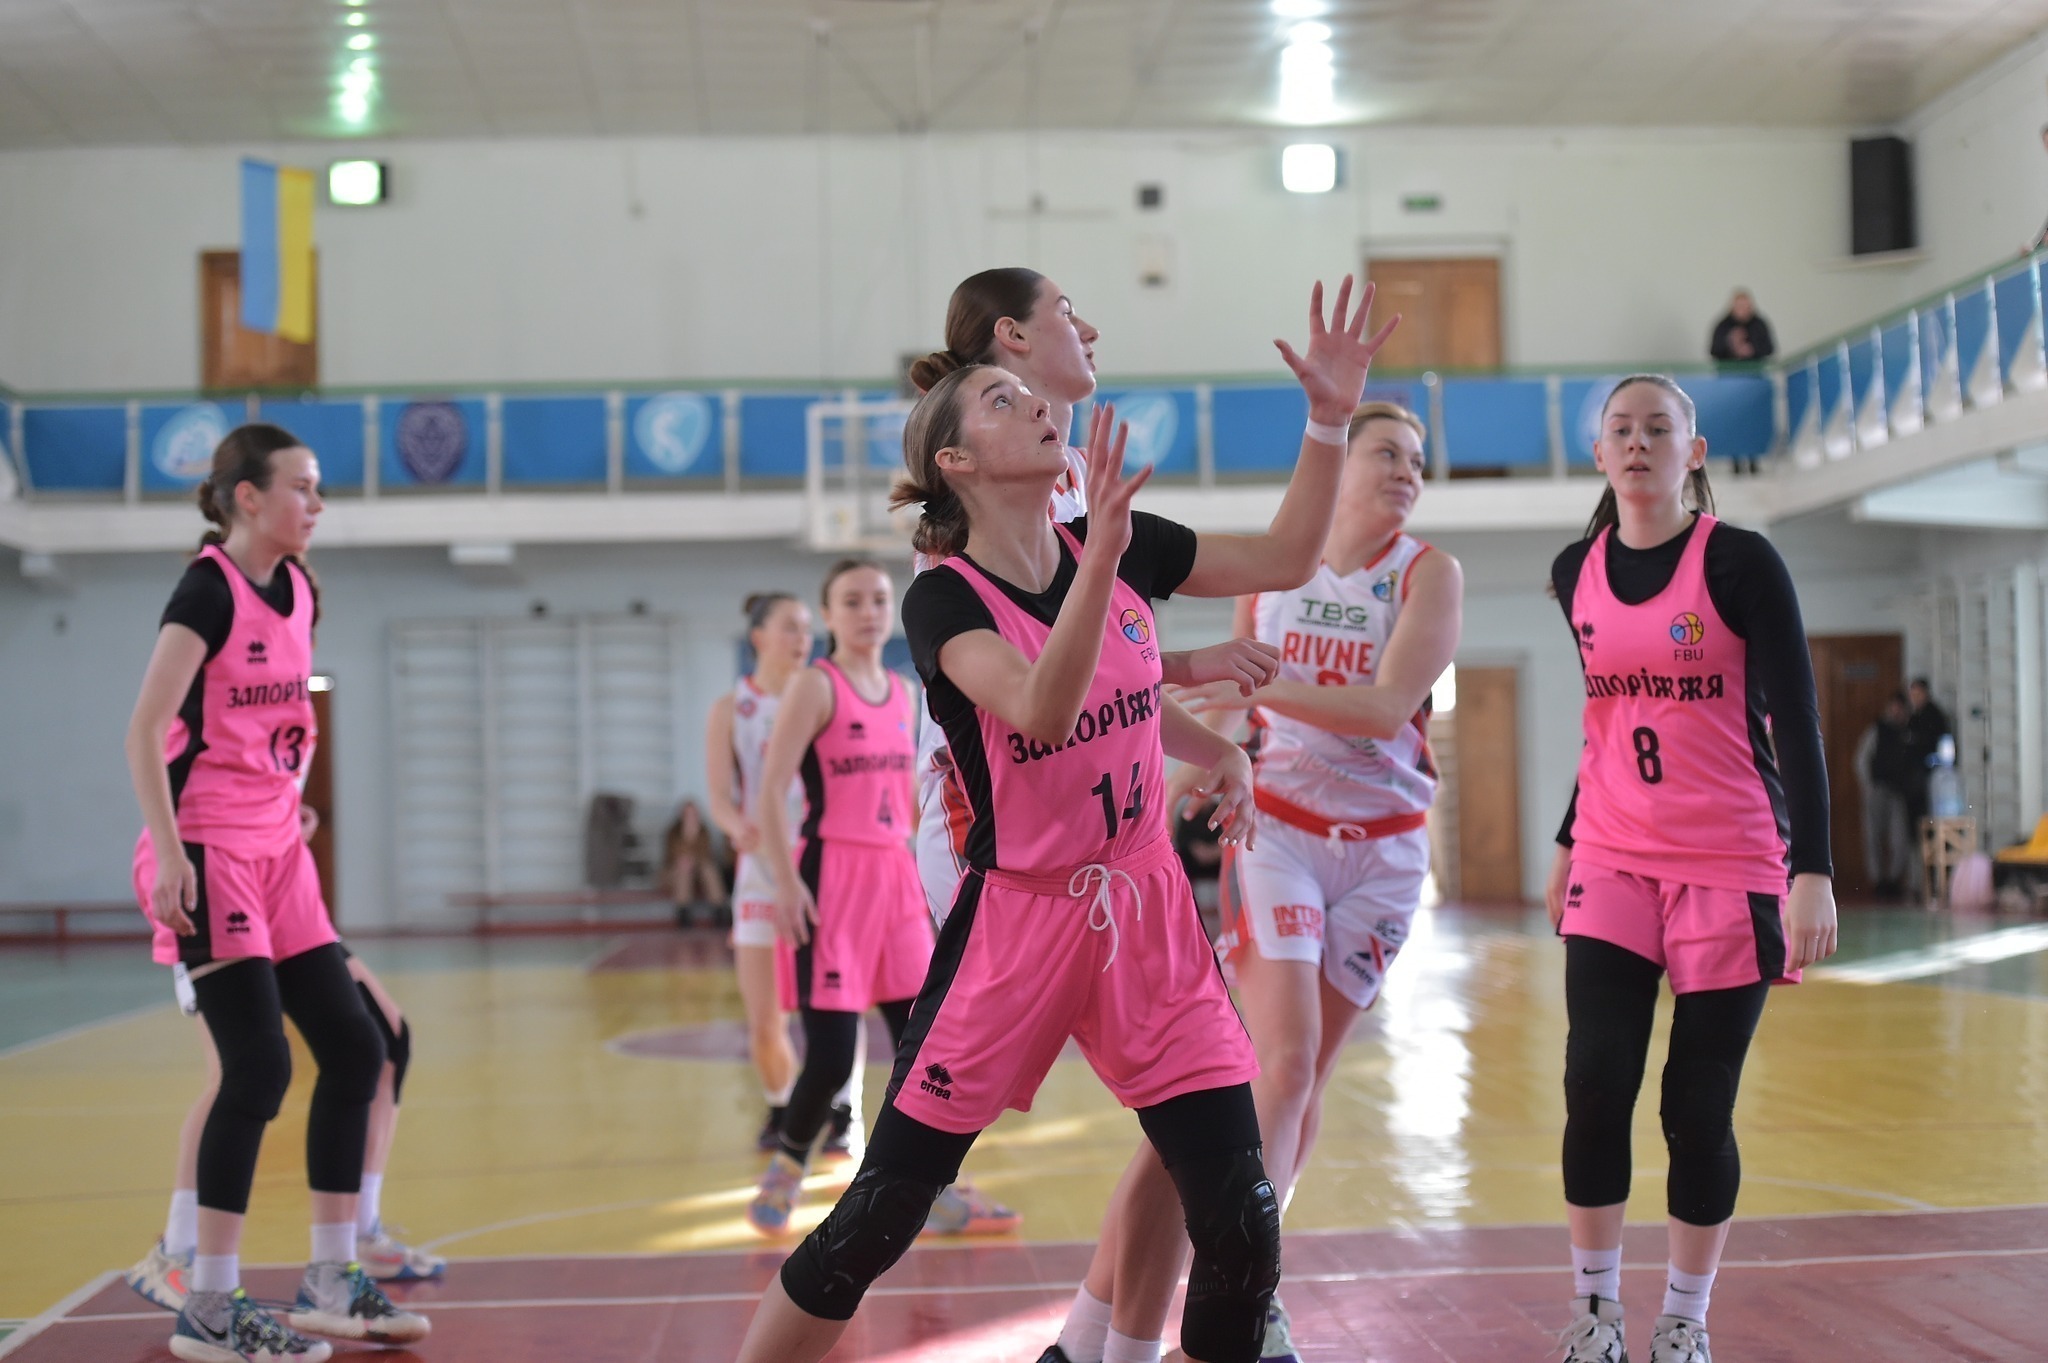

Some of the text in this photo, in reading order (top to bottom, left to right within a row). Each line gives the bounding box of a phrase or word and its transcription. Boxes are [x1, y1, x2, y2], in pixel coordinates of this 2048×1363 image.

[1301, 598, 1368, 625] TBG
[1283, 631, 1374, 675] RIVNE
[1674, 648, 1704, 662] FBU
[1632, 726, 1663, 785] 8
[1090, 760, 1143, 842] 14
[921, 1080, 951, 1101] errea
